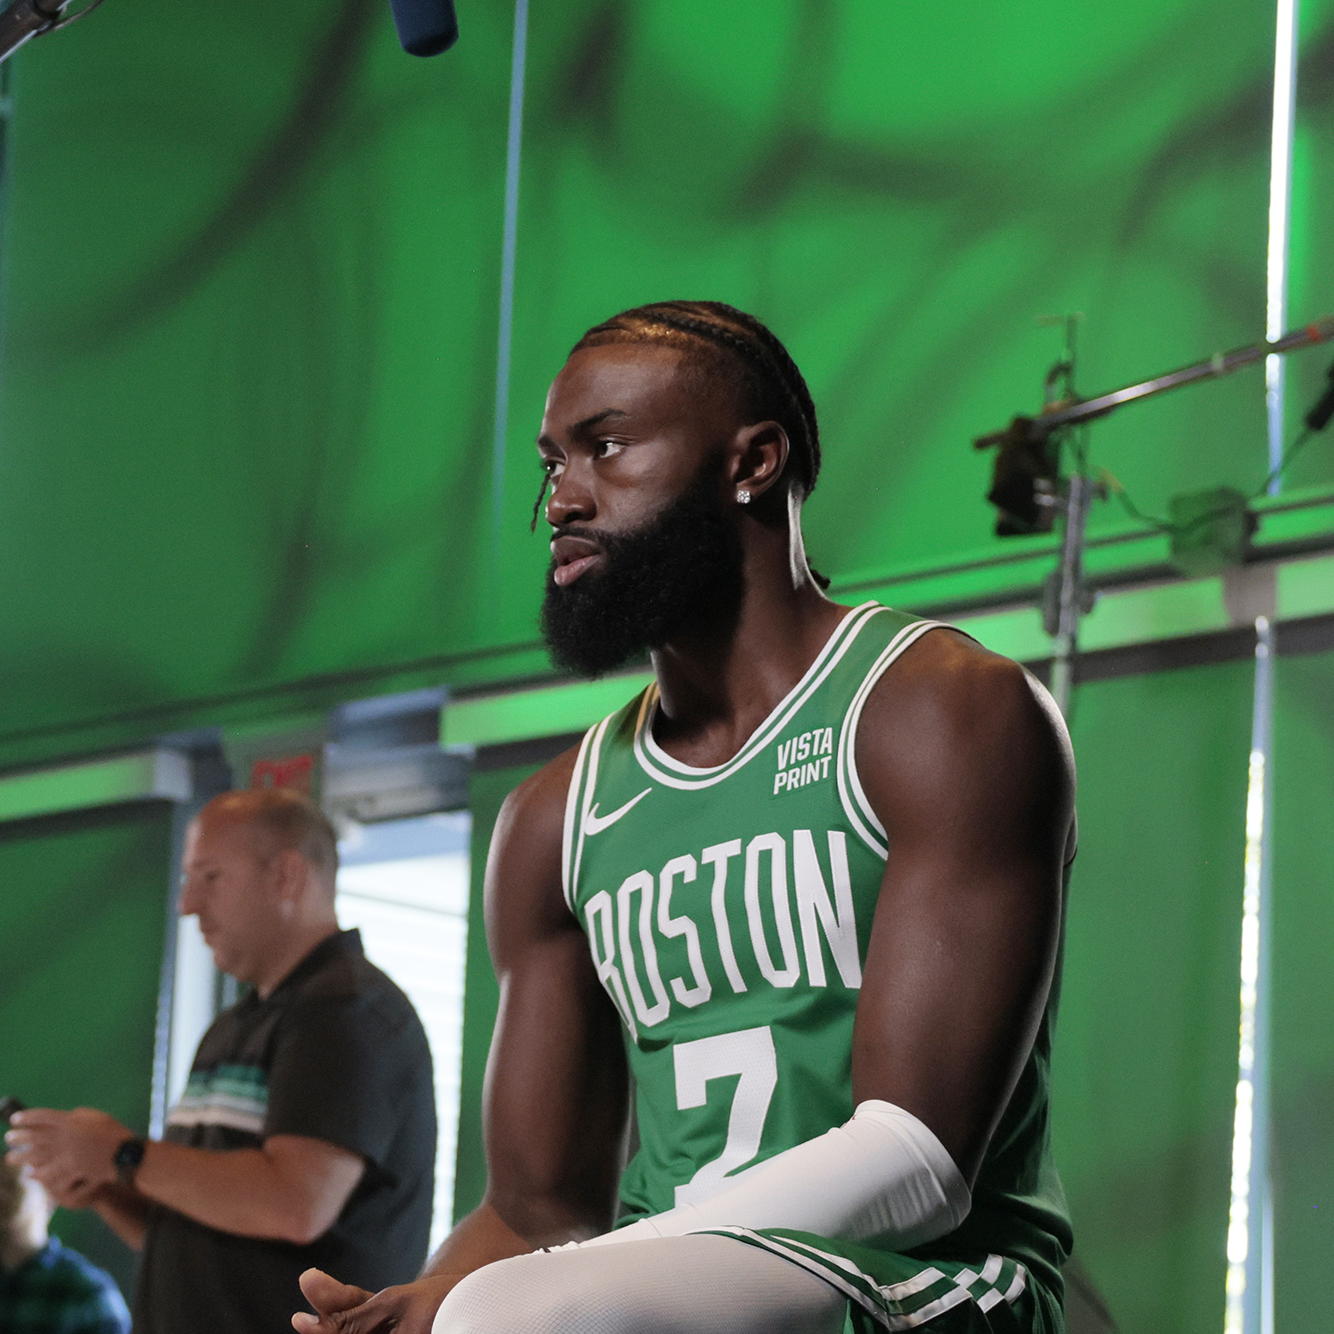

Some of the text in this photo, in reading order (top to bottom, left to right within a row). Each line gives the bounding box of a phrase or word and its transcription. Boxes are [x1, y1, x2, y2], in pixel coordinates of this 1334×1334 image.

[773, 755, 832, 795] PRINT
[777, 727, 833, 771] VISTA
[584, 829, 863, 1045] BOSTON
[672, 1025, 778, 1208] 7
